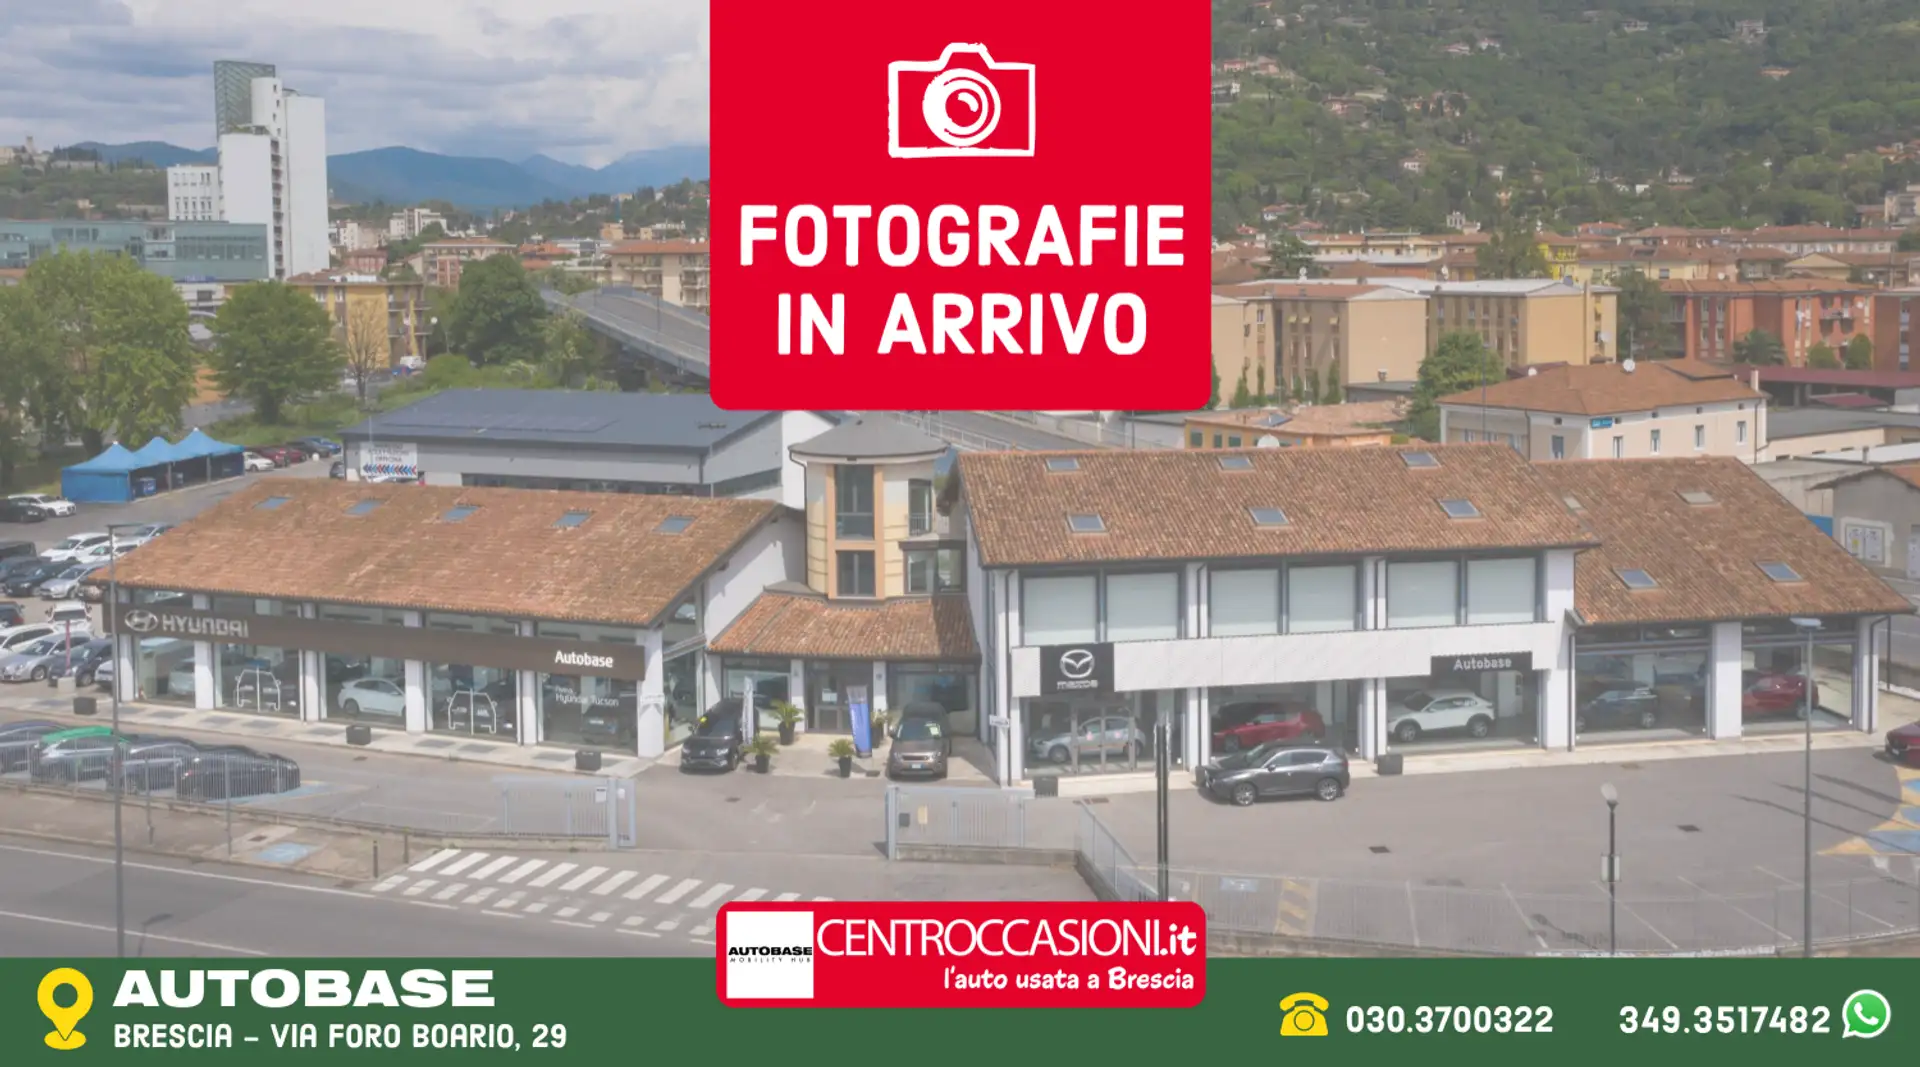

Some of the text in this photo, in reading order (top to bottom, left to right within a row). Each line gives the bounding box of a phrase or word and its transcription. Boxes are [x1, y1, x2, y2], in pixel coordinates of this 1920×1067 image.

[162, 614, 249, 638] HYUNDAI
[555, 650, 614, 668] Autobase
[1453, 657, 1512, 671] Autobase
